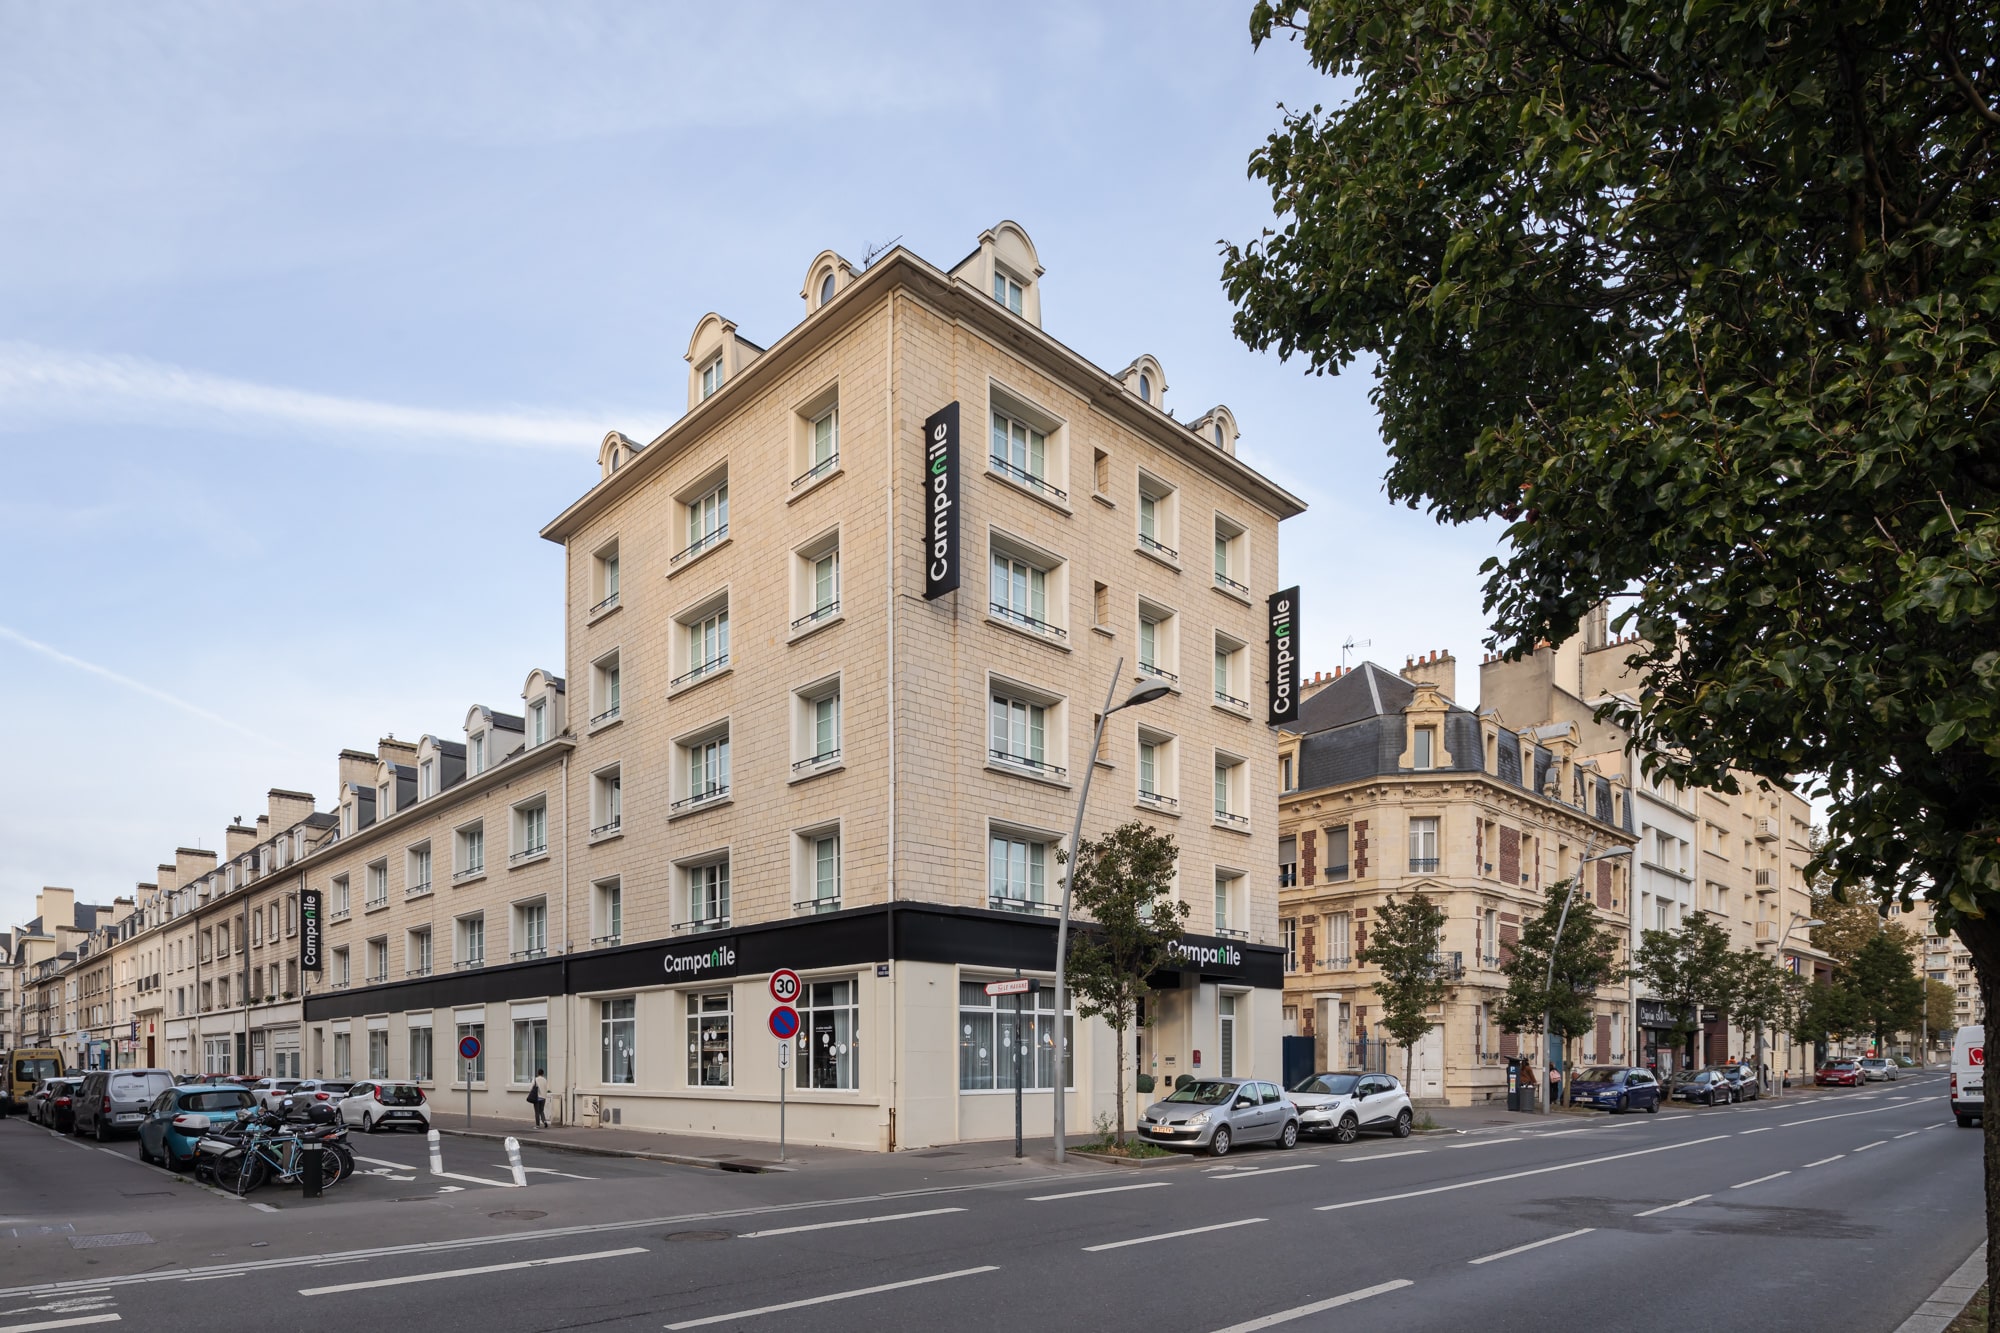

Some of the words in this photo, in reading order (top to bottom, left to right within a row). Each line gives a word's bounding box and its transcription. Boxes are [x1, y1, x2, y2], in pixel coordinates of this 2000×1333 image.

[929, 423, 952, 582] Campanile
[1273, 599, 1295, 714] Campanile
[303, 895, 319, 966] Campanile
[1167, 939, 1241, 968] Campanile
[664, 945, 736, 975] Campanile
[776, 978, 795, 994] 30
